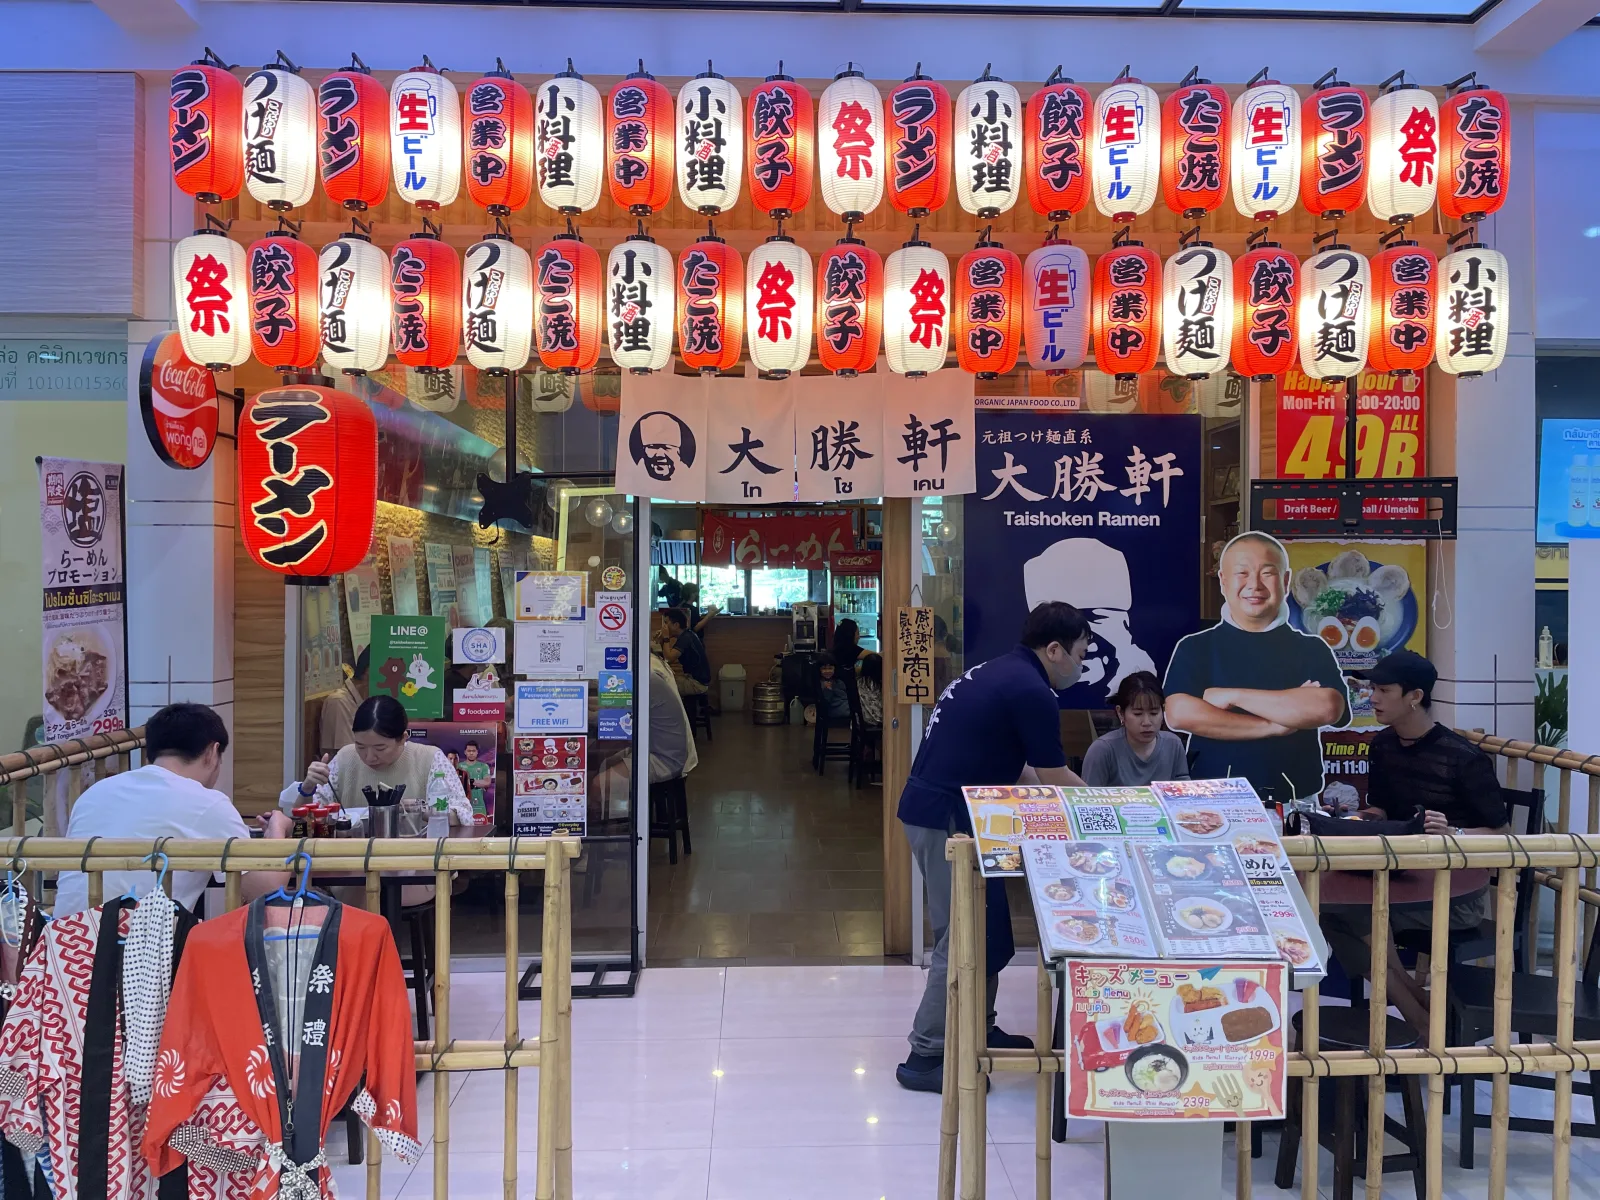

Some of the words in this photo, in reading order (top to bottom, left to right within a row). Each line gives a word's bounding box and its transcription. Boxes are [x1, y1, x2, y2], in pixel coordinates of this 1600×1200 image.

[170, 70, 209, 176] ラーメン
[244, 72, 285, 184] つけ麺
[319, 78, 359, 182] ラーメン
[471, 84, 505, 184] 営業中
[538, 85, 575, 188] 小料理
[614, 87, 648, 187] 営業中
[685, 86, 726, 191] 小料理
[752, 86, 793, 190] 餃子
[832, 100, 874, 180] 祭
[892, 86, 936, 192] ラーメン
[971, 90, 1012, 193] 小料理
[1041, 89, 1083, 190] 餃子
[1178, 90, 1221, 191] たこ焼
[1318, 92, 1364, 194] ラーメン
[1399, 106, 1436, 187] 祭
[1454, 97, 1500, 197] たこ焼
[186, 253, 232, 337] 祭
[251, 243, 293, 346] 餃子
[320, 242, 355, 353] つけ麺
[392, 247, 428, 352] たこ焼
[465, 242, 504, 353] つけ麺
[538, 249, 577, 353] たこ焼
[612, 250, 652, 352] 小料理
[682, 250, 722, 354] たこ焼
[757, 261, 796, 342] 祭
[824, 252, 866, 353] 餃子
[909, 268, 945, 349] 祭
[968, 257, 1005, 357] 営業中
[1109, 257, 1147, 357] 営業中
[1175, 250, 1221, 359] つけ麺
[1249, 257, 1294, 355] 餃子
[1314, 253, 1360, 363] つけ麺
[1391, 254, 1430, 353] 営業中
[1449, 257, 1496, 357] 小料理
[166, 431, 206, 450] wongnai
[975, 398, 1005, 406] ORGANIC
[981, 428, 1093, 445] 元祖つけ麺直系
[1283, 395, 1335, 410] Mon-Fri
[1391, 415, 1418, 431] ALL
[250, 389, 333, 567] ラーメン
[981, 446, 1184, 508] 大勝軒
[1004, 511, 1094, 527] Taishoken
[1098, 511, 1160, 527] Ramen
[1284, 505, 1308, 513] Draft
[1310, 505, 1332, 513] Beer
[1384, 505, 1419, 514] Umeshu
[48, 568, 118, 586] プロモーション
[61, 548, 108, 568] らーめん
[390, 626, 428, 636] LINE@
[467, 708, 500, 717] foodpanda
[1326, 742, 1355, 755] Time
[1074, 788, 1139, 796] LINE@
[1324, 760, 1340, 774] Fri
[1343, 760, 1369, 774] 11:0
[1075, 988, 1099, 997] Kids
[1104, 988, 1129, 998] Menu
[1076, 964, 1189, 987] キッズメニュー
